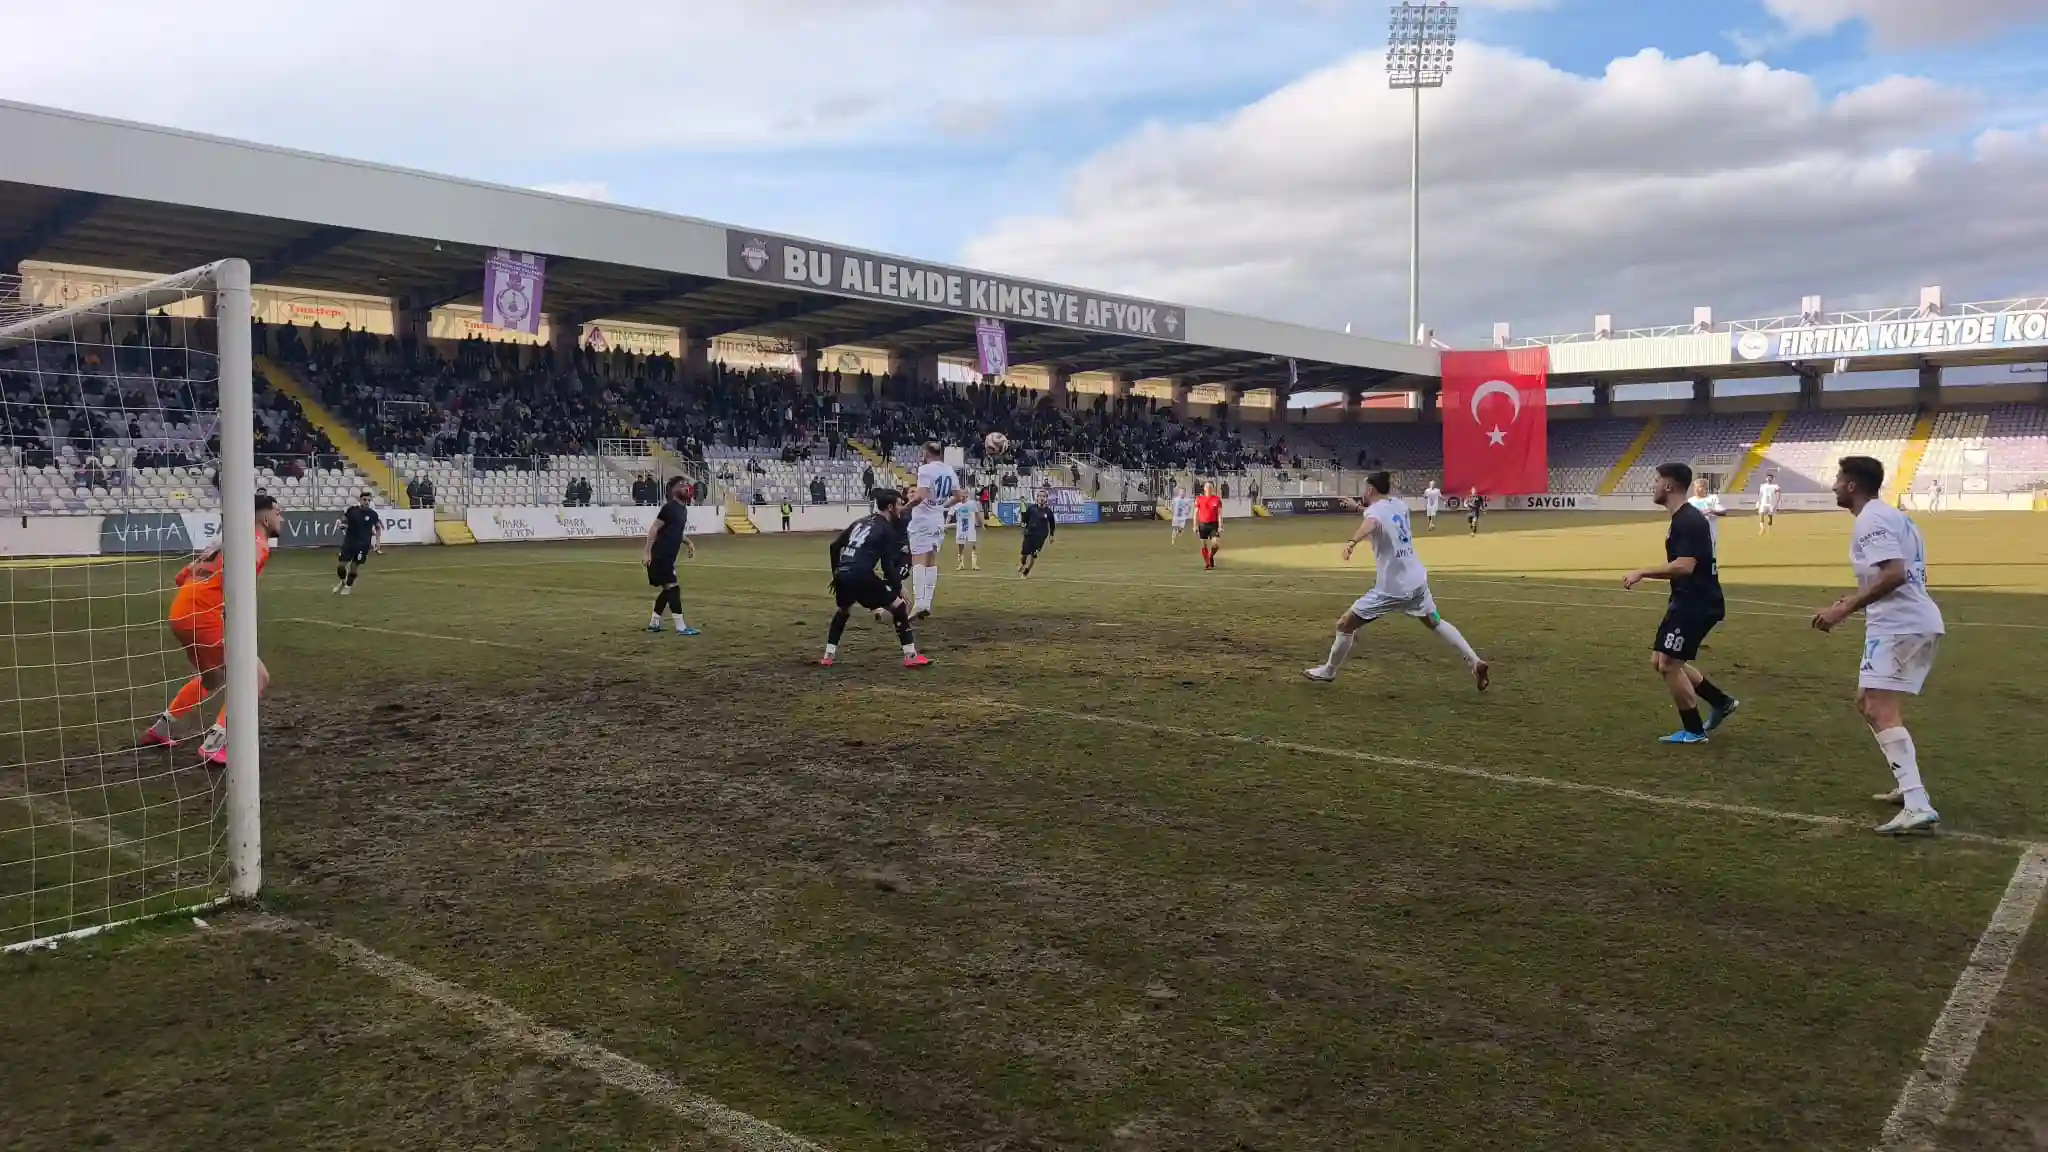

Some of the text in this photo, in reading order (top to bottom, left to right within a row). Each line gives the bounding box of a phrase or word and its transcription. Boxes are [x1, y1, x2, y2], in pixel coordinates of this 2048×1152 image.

[783, 245, 832, 286] BU
[840, 256, 962, 307] ALEMDE
[1084, 298, 1157, 334] AFYOK
[1777, 311, 2048, 356] FIRTINA KUZEYDE KO
[934, 475, 953, 498] 10
[1527, 496, 1576, 508] SAYGIN
[1664, 633, 1685, 652] 88
